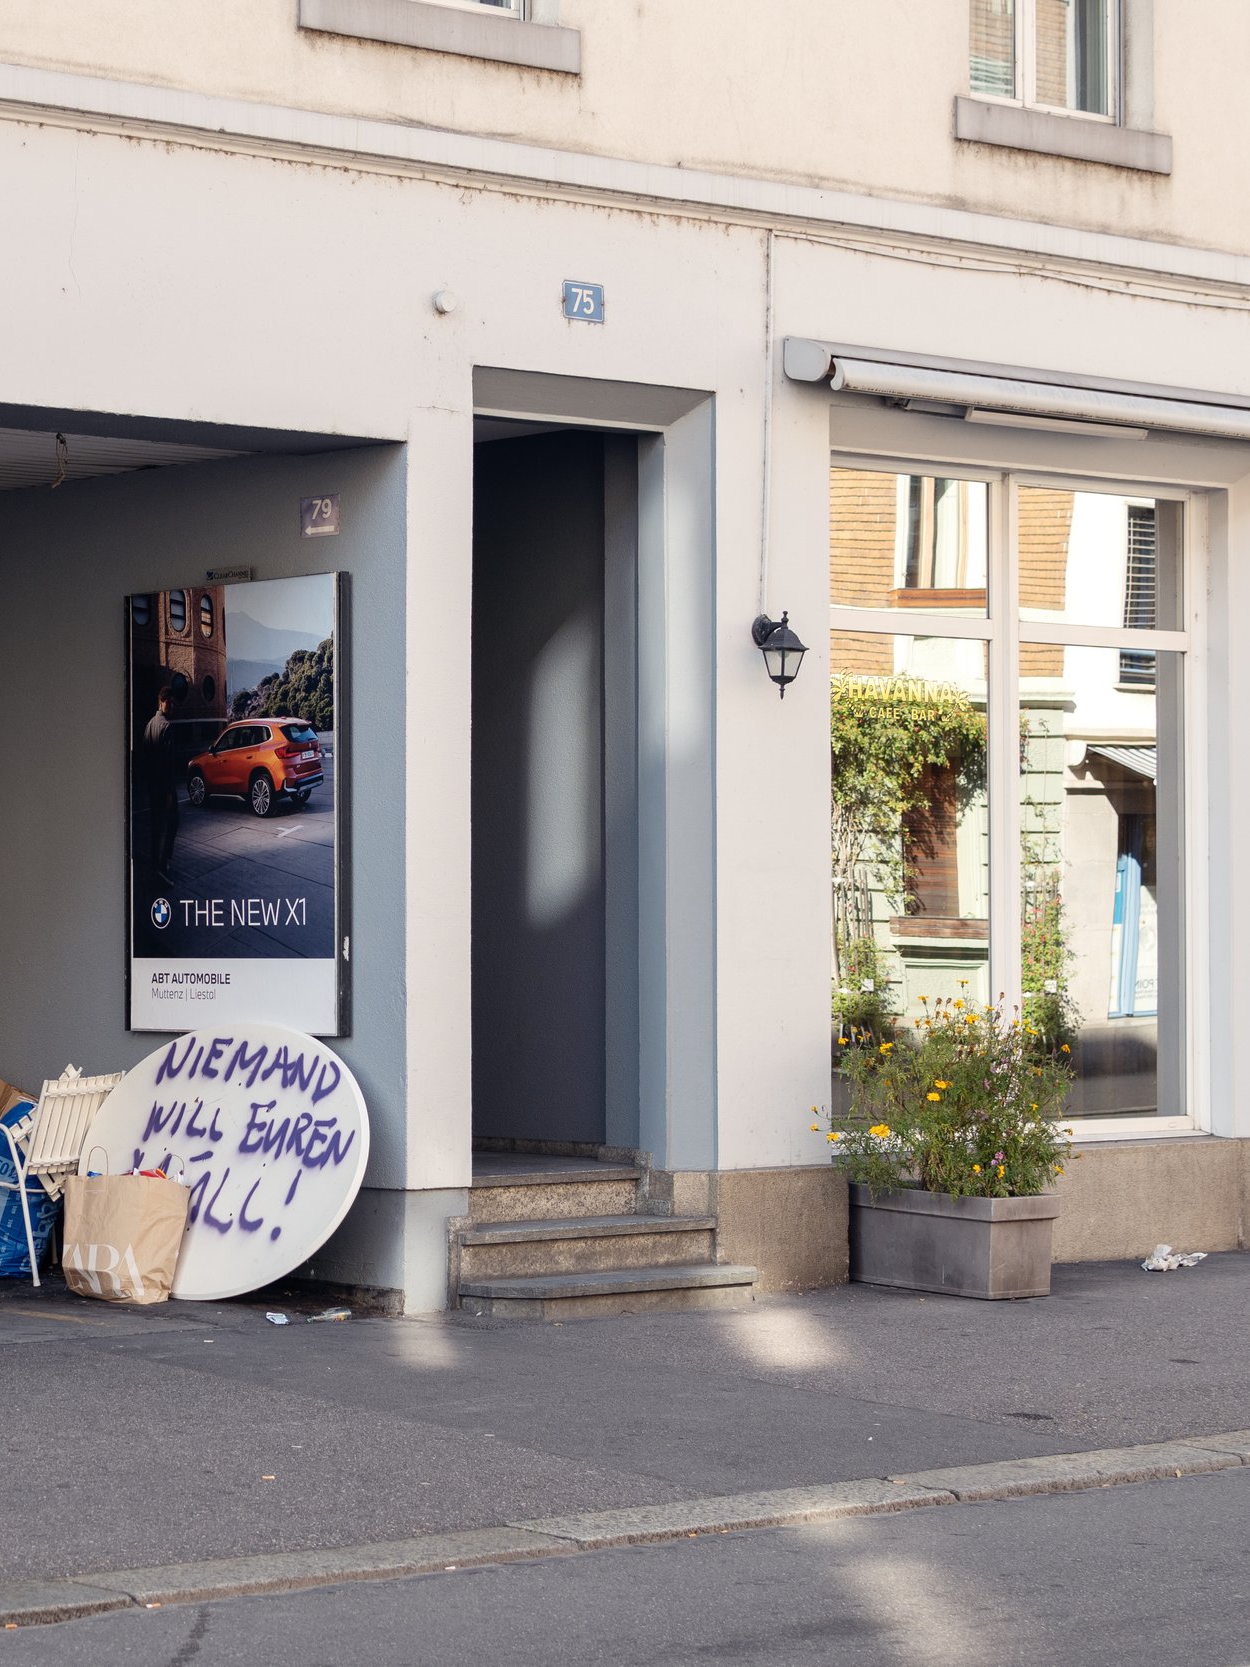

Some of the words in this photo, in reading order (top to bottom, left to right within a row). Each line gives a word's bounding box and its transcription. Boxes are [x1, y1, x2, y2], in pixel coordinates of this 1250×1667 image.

[571, 287, 595, 315] 75
[311, 498, 332, 520] 79
[848, 676, 954, 703] HAVANNA
[911, 708, 935, 721] BAR
[180, 899, 225, 927] THE
[231, 898, 281, 926] NEW
[285, 897, 306, 926] X1
[151, 972, 170, 984] ABT
[171, 972, 231, 985] AUTOMOBILE
[151, 987, 184, 1000] Muttenz
[155, 1036, 342, 1106] NIEMAND
[141, 1100, 224, 1143] WILL
[238, 1099, 356, 1171] EUREN
